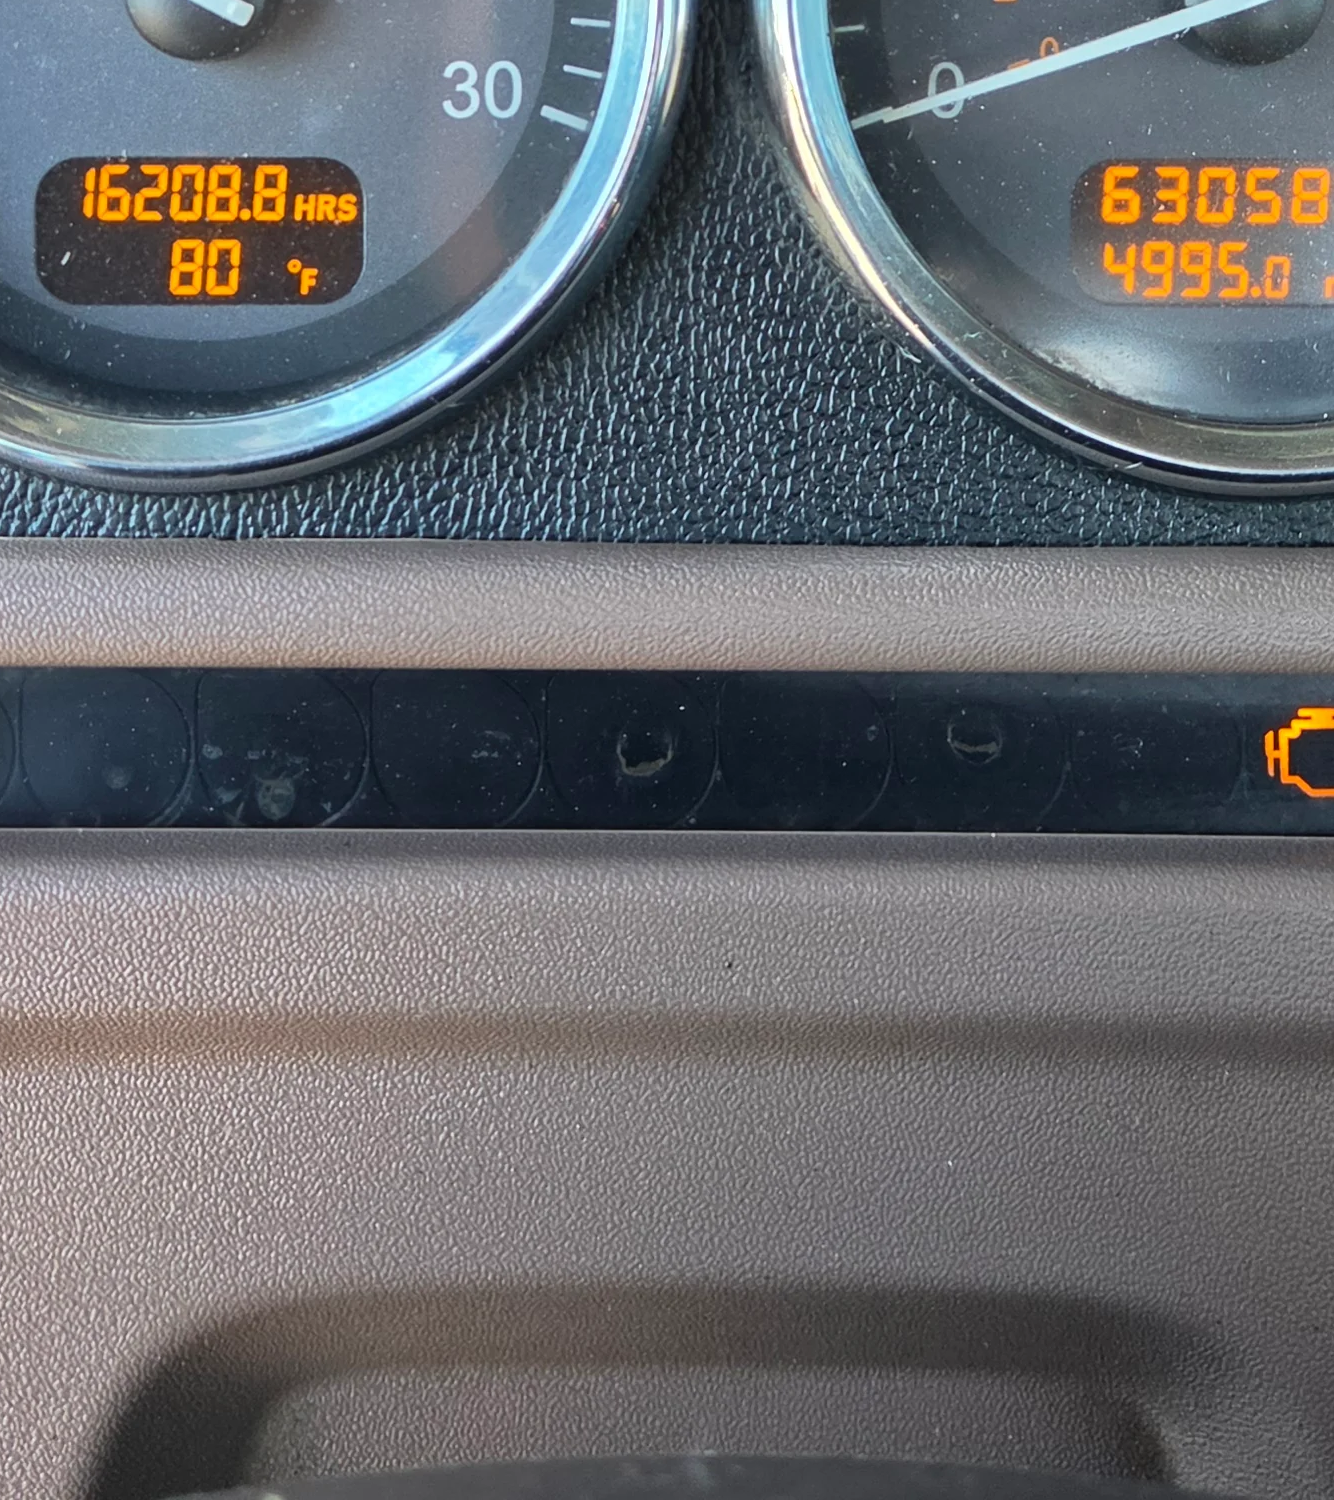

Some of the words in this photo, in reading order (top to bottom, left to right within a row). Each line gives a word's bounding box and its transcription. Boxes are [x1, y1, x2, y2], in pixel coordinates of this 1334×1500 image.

[441, 60, 523, 119] 30
[928, 61, 965, 119] 0
[83, 164, 288, 222] 16208.8
[293, 193, 358, 222] HRS
[169, 239, 241, 296] 80
[1103, 241, 1291, 299] 4995.0
